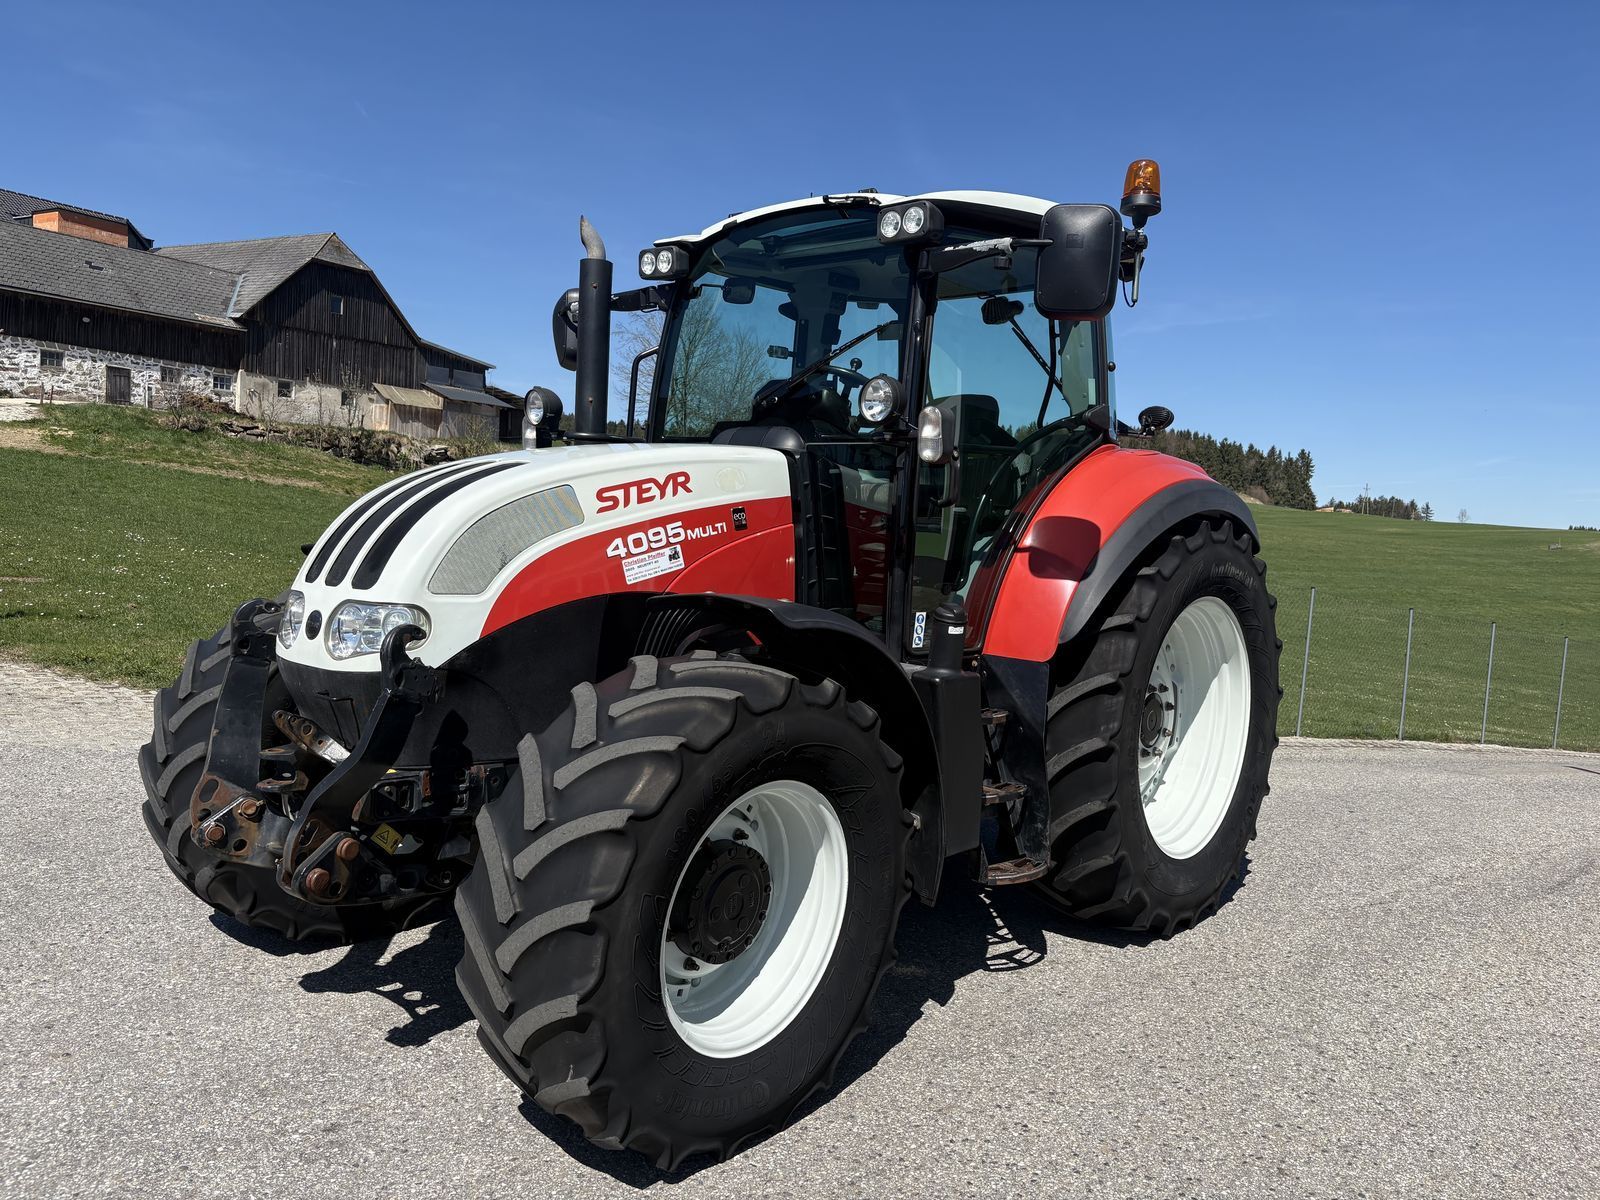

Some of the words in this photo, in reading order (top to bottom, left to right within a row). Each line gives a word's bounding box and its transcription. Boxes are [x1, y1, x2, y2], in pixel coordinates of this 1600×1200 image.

[595, 471, 693, 514] STEYR
[606, 520, 686, 558] 4095
[687, 521, 727, 541] MULTI
